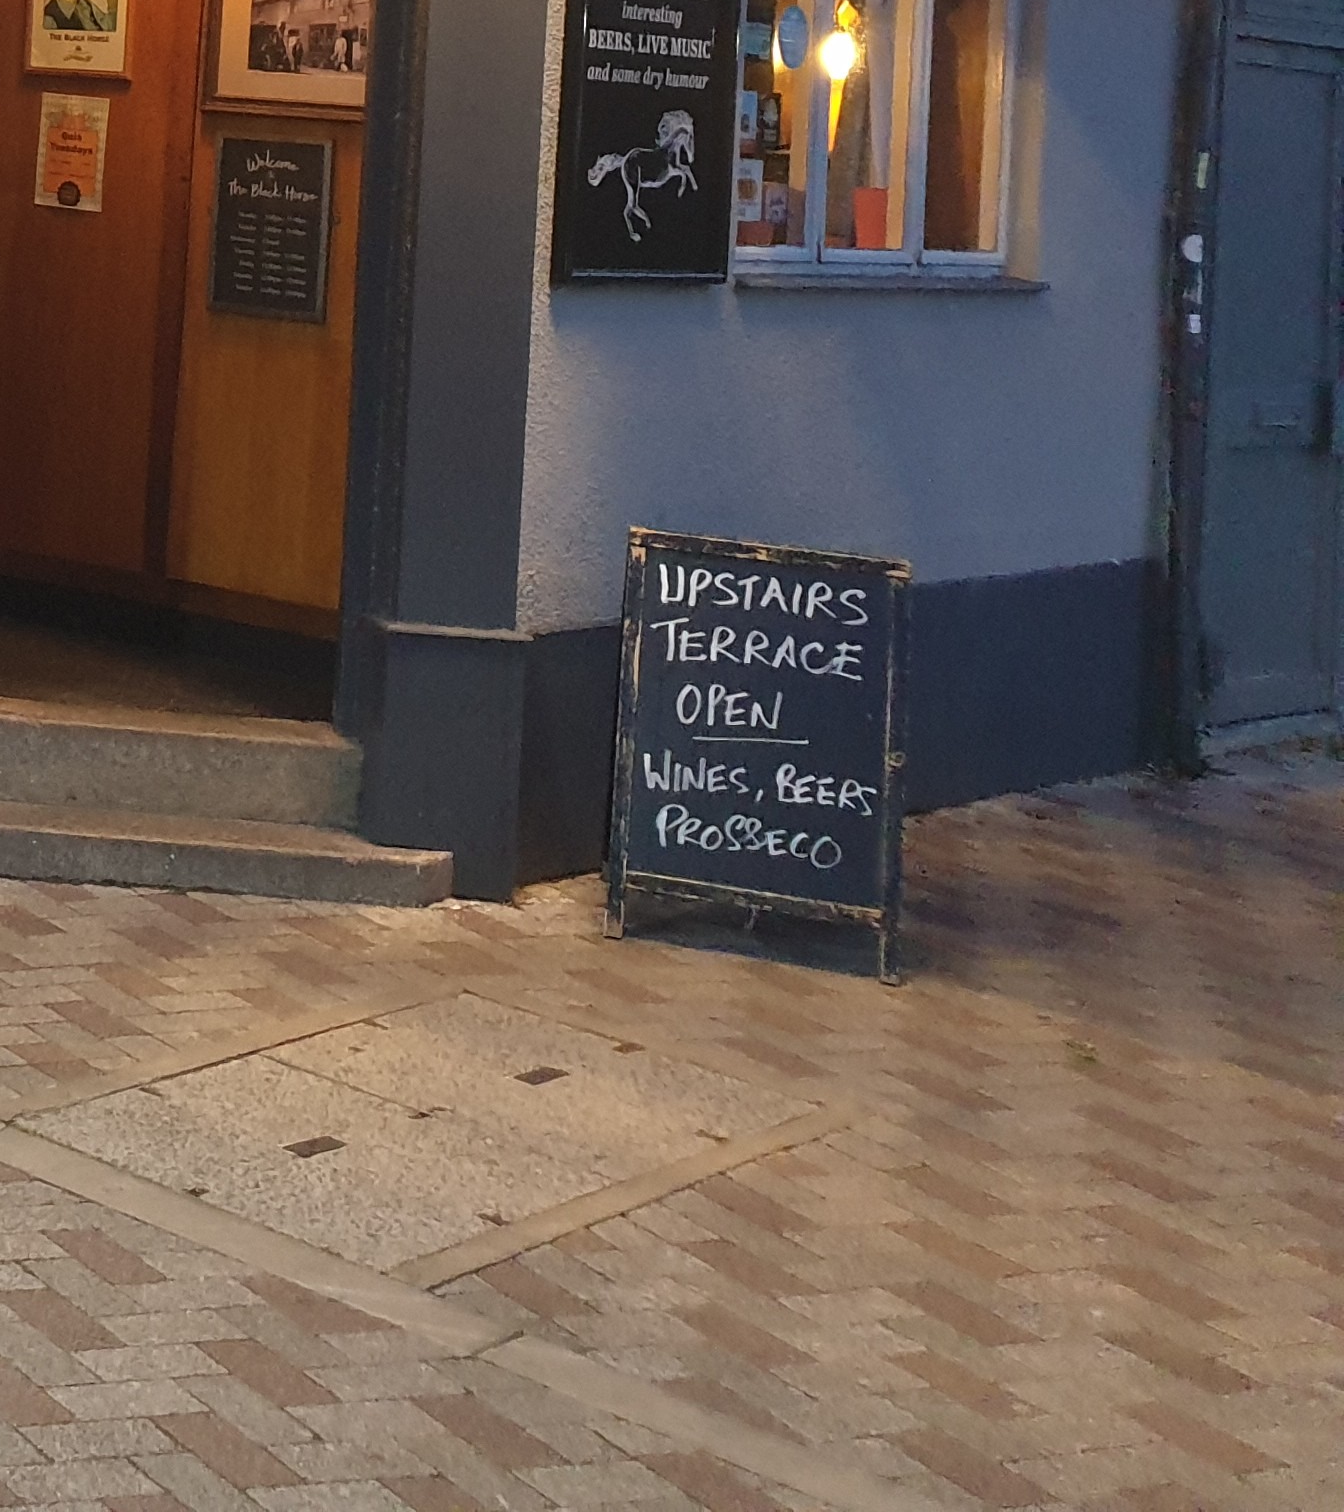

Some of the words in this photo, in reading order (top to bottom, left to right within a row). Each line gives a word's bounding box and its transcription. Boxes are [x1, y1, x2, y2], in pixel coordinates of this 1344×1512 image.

[622, 0, 683, 28] interesting
[588, 28, 635, 55] BEERS,
[637, 34, 669, 54] LIVE
[670, 38, 711, 59] MUSIC
[587, 63, 609, 82] and
[612, 66, 641, 85] some
[643, 65, 663, 90] dry
[665, 68, 710, 90] humour
[246, 149, 300, 172] Welcome
[228, 177, 248, 196] The
[251, 180, 282, 198] Black
[285, 184, 319, 202] Horse
[659, 563, 868, 626] UPSTAIRS
[650, 617, 863, 681] TERRACE
[675, 684, 783, 730] OPEN
[643, 749, 763, 803] WINES,
[776, 763, 877, 816] BEERS
